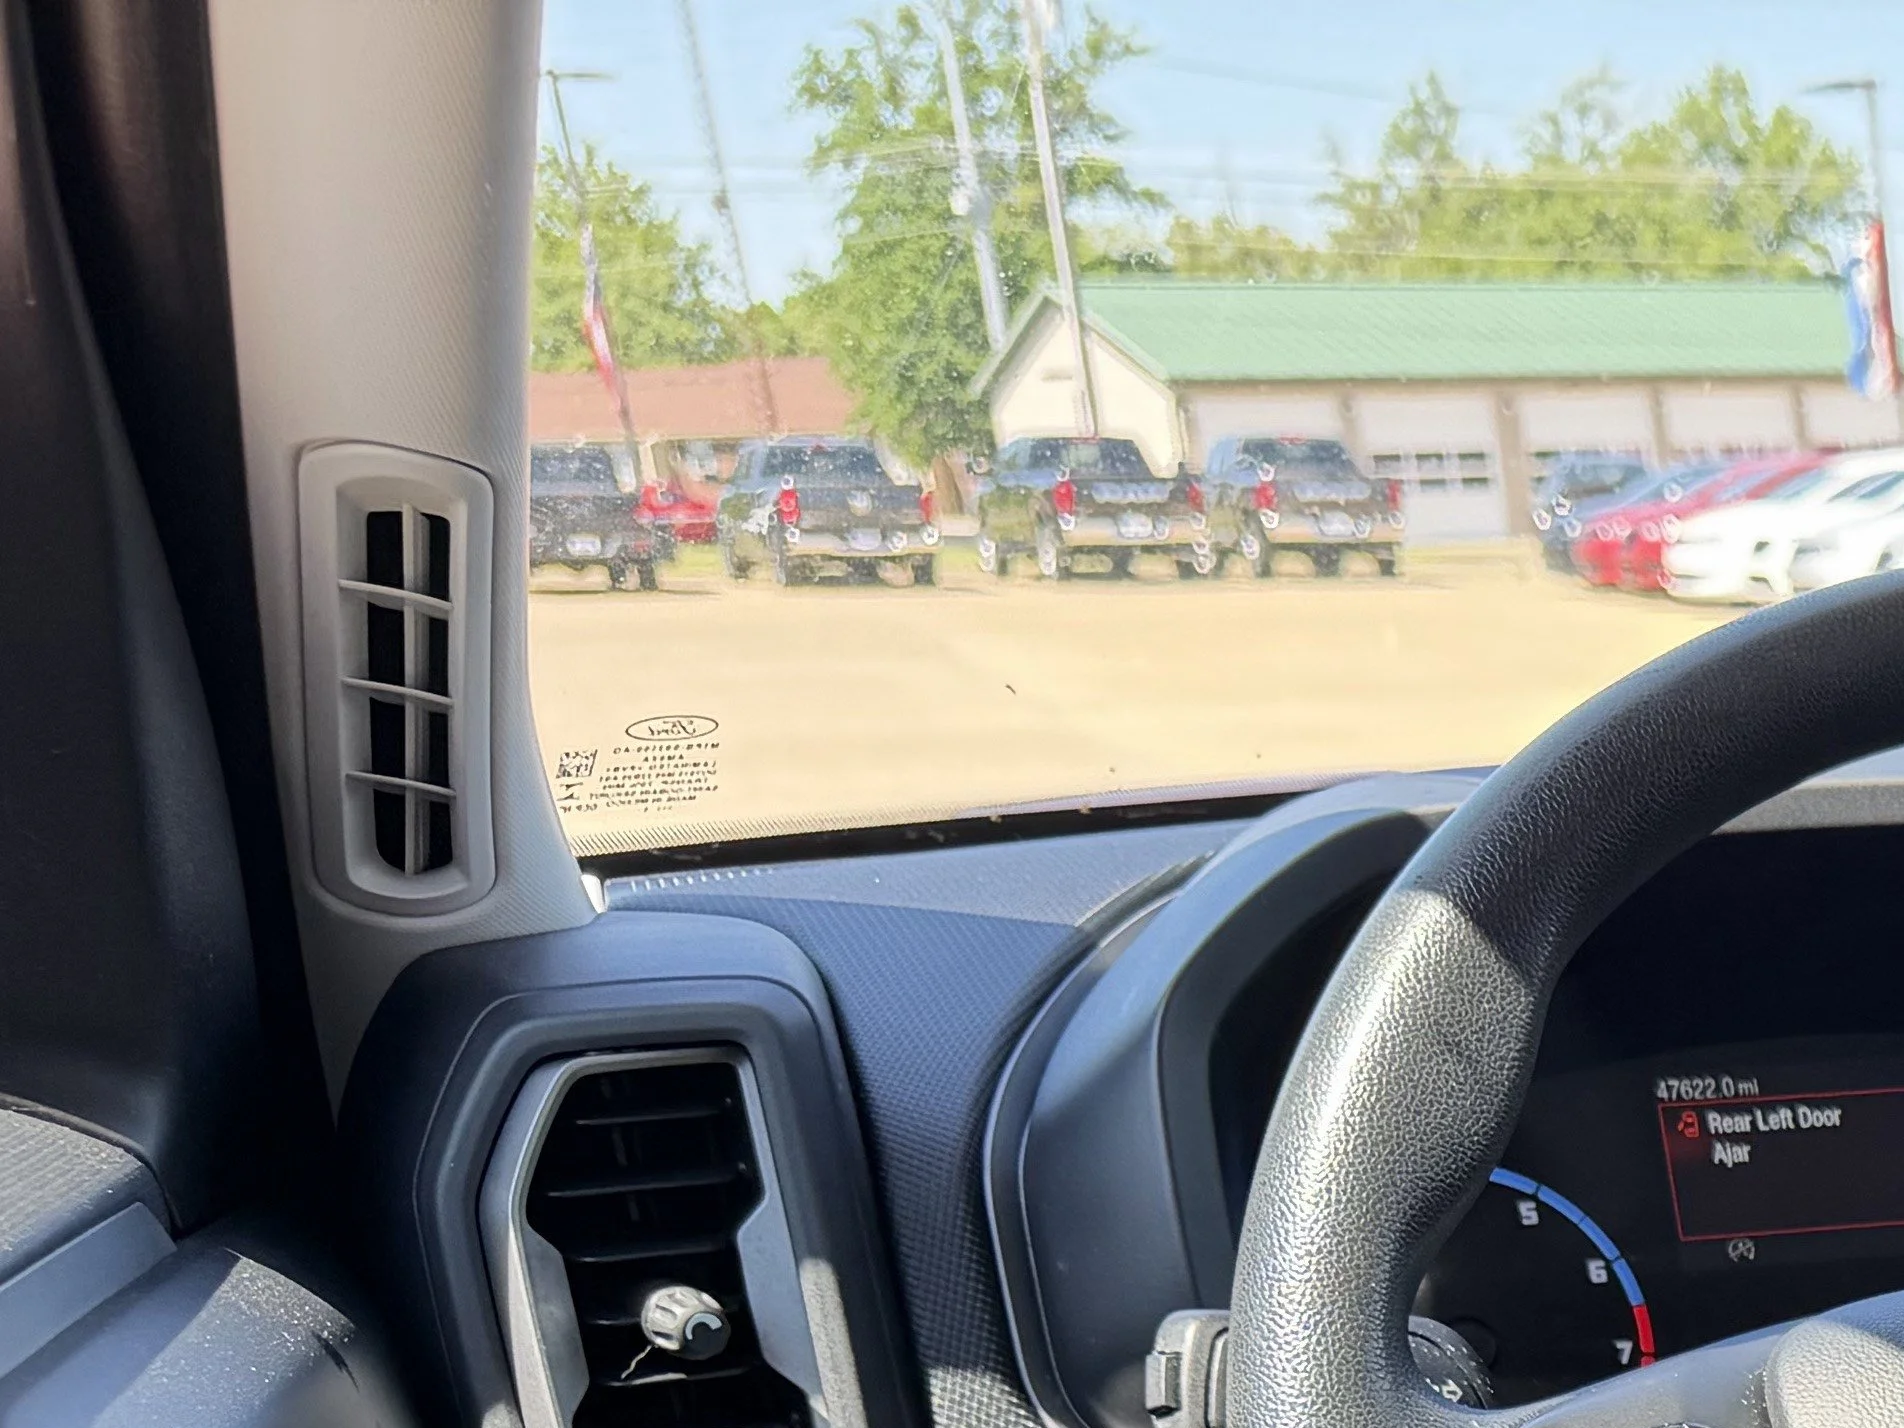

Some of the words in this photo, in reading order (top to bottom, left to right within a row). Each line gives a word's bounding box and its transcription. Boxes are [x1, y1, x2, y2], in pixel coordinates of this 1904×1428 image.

[1656, 1077, 1734, 1102] 47622.0
[1738, 1078, 1759, 1097] mi
[1707, 1107, 1752, 1135] Rear
[1753, 1105, 1795, 1131] Left
[1797, 1104, 1842, 1129] Door
[1711, 1141, 1751, 1168] Ajar
[1516, 1199, 1541, 1227] 5
[1585, 1257, 1609, 1285] 6
[1612, 1338, 1634, 1366] 7
